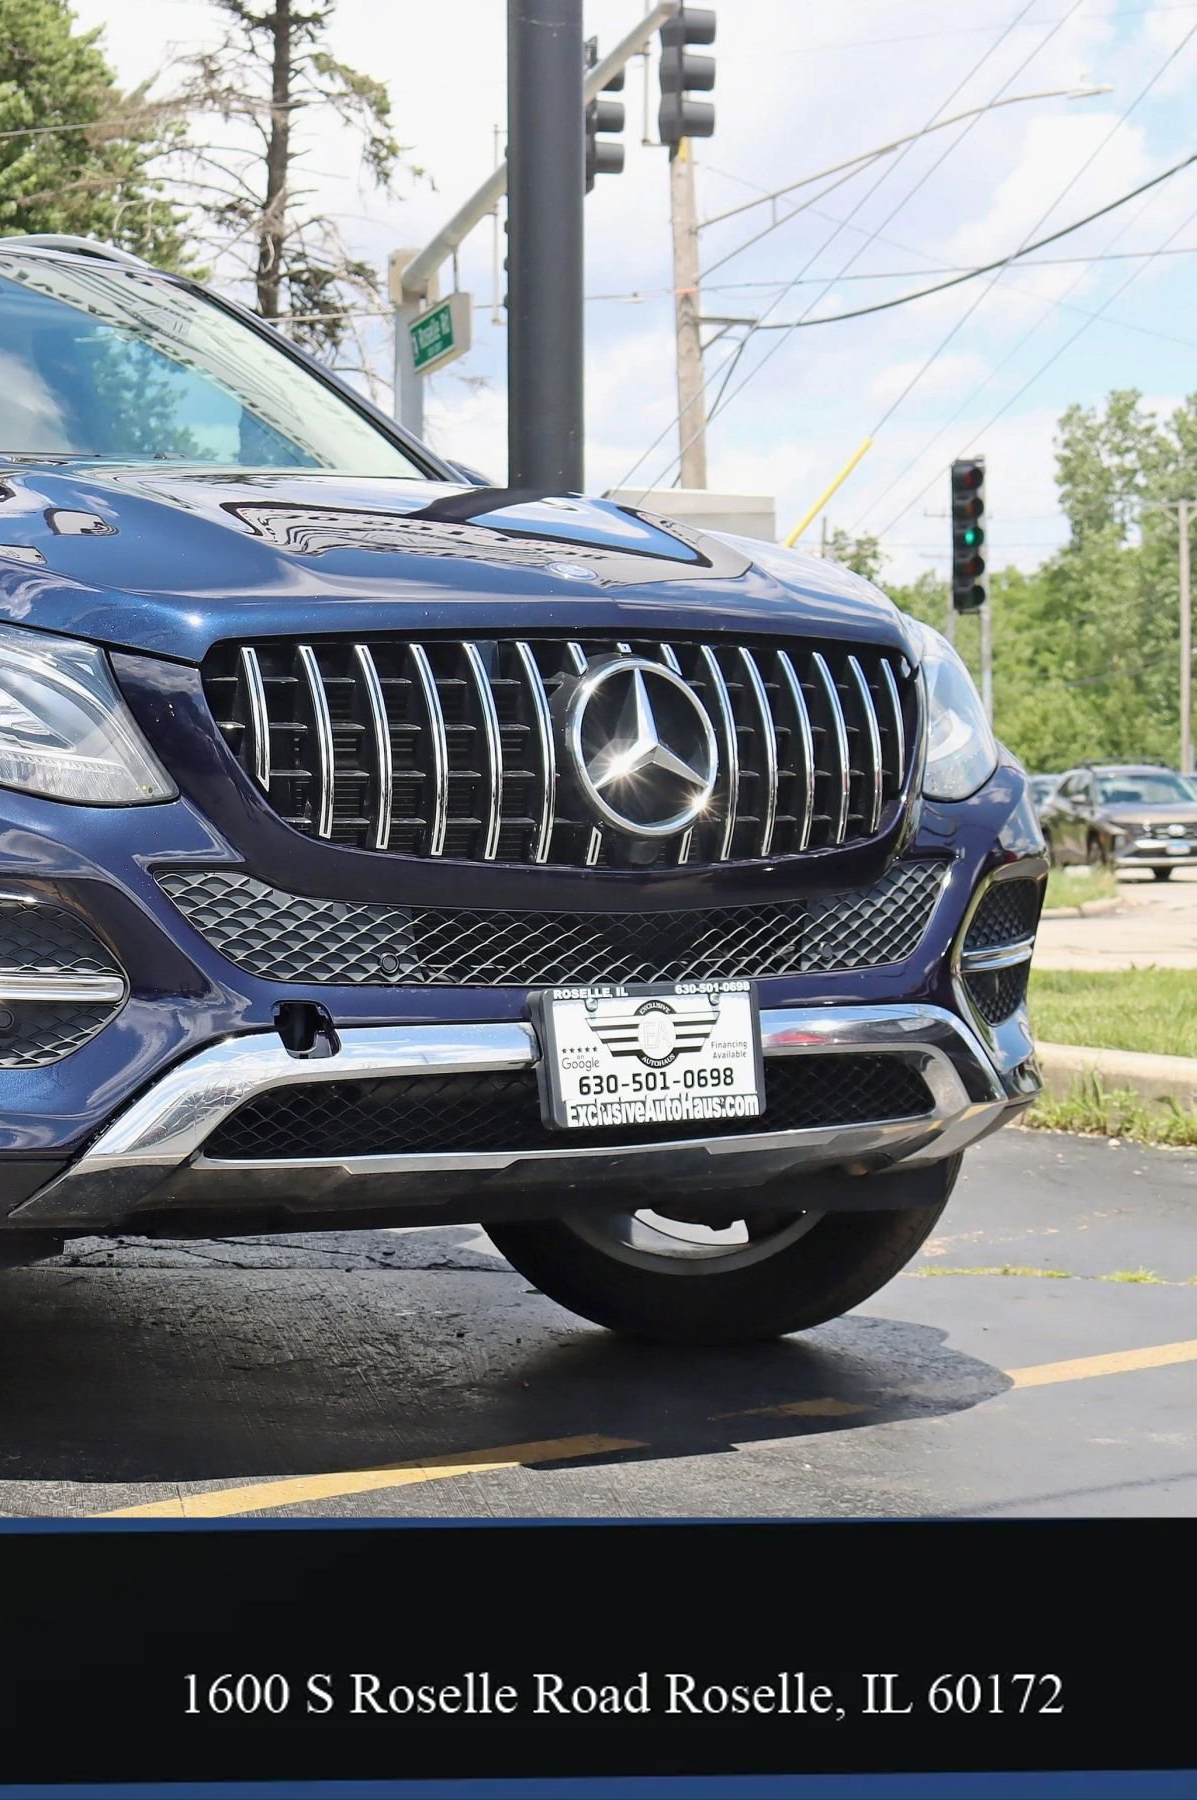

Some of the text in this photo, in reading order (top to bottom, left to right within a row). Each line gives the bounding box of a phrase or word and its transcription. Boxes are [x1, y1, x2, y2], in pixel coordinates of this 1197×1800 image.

[553, 986, 629, 1000] ROSELLE, IL
[674, 981, 751, 995] 630-501-0698
[639, 1002, 672, 1016] EXCLUSIVE
[643, 1020, 672, 1049] EA
[710, 1040, 748, 1051] Financing
[641, 1053, 676, 1068] AUTOHAUS
[712, 1049, 748, 1060] Available
[561, 1056, 600, 1072] Google
[578, 1066, 734, 1096] 630-501-0698
[566, 1093, 760, 1128] ExclusiveAutoHaus.com
